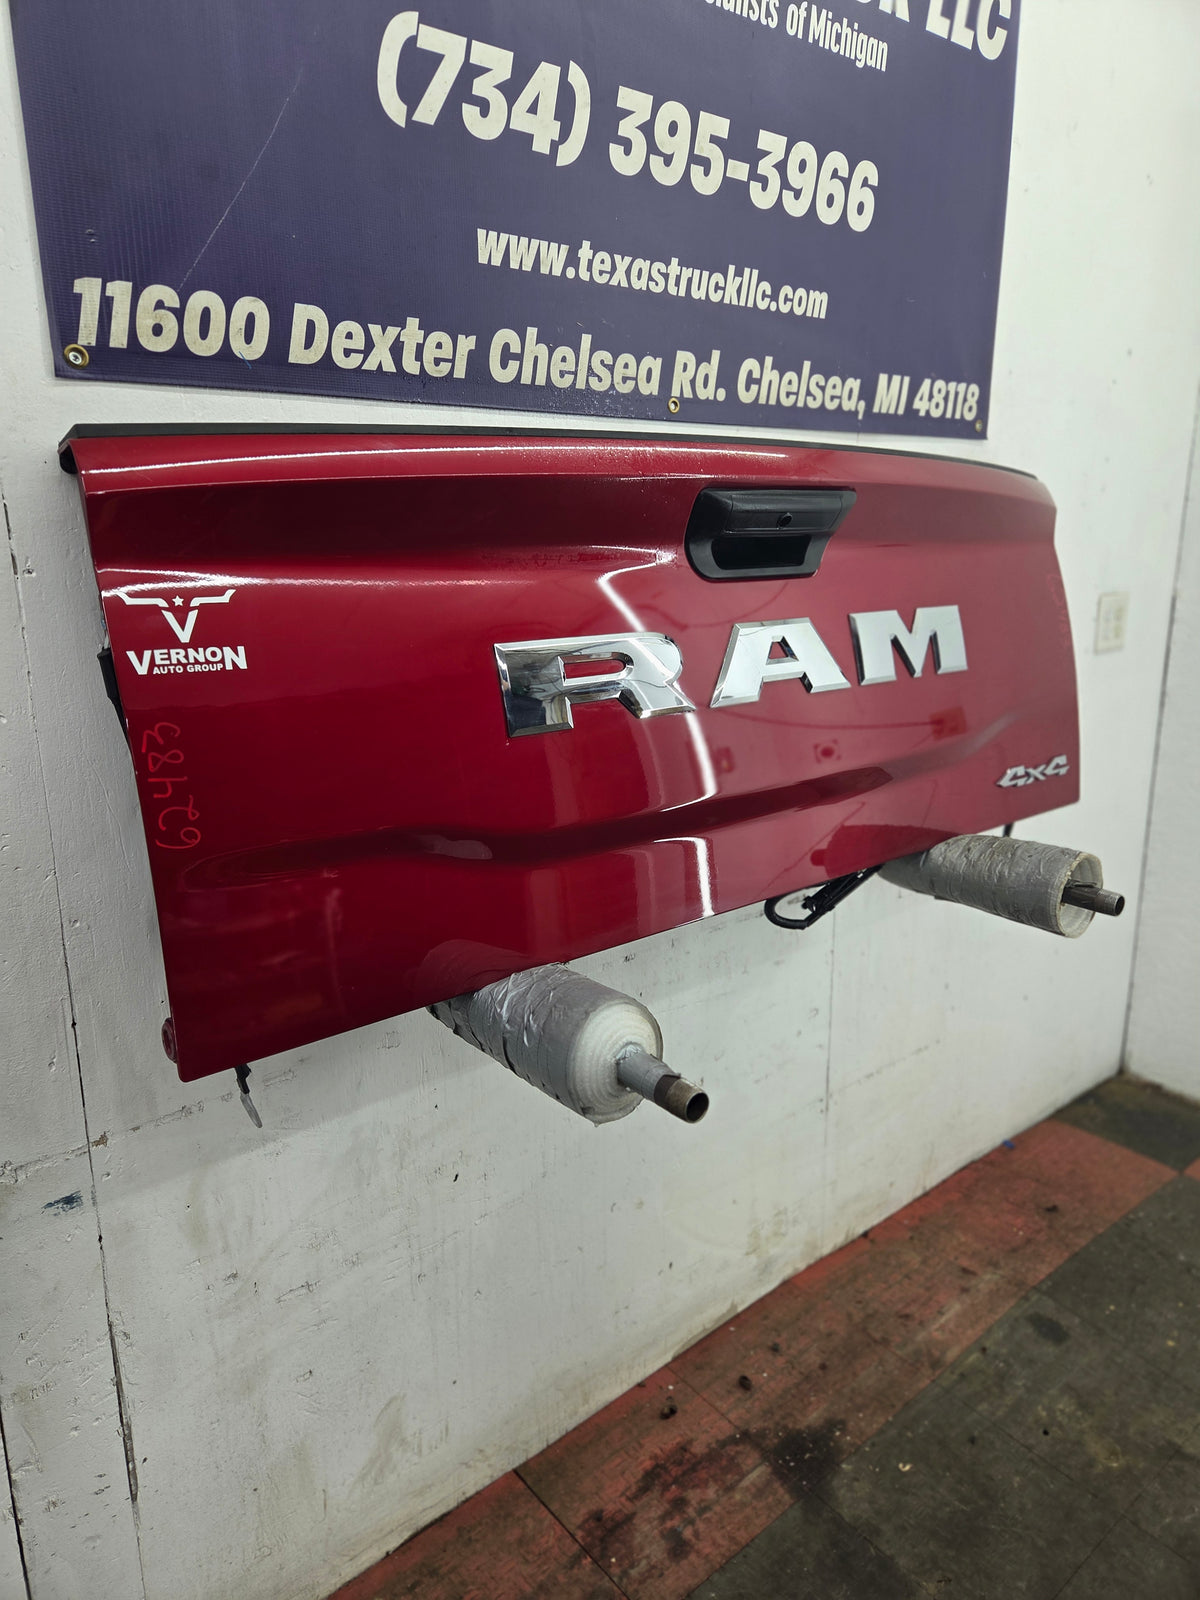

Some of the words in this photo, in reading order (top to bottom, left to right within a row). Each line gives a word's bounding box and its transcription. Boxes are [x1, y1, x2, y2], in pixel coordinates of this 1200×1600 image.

[786, 1, 808, 39] of
[808, 4, 888, 73] Michigan
[376, 10, 591, 167] (734)
[609, 85, 879, 233] 395-3966
[476, 227, 829, 320] www.texastruckllc.com
[72, 277, 271, 361] 11600
[288, 302, 477, 380] Dexter
[488, 326, 663, 398] Chelsea
[671, 349, 727, 404] Rd.
[737, 355, 866, 420] Chelsea,
[872, 372, 911, 416] MI
[912, 377, 981, 421] 48118
[125, 645, 248, 675] VERNON
[152, 664, 184, 675] AUTO
[186, 662, 224, 673] GROUP
[493, 604, 969, 738] RAM
